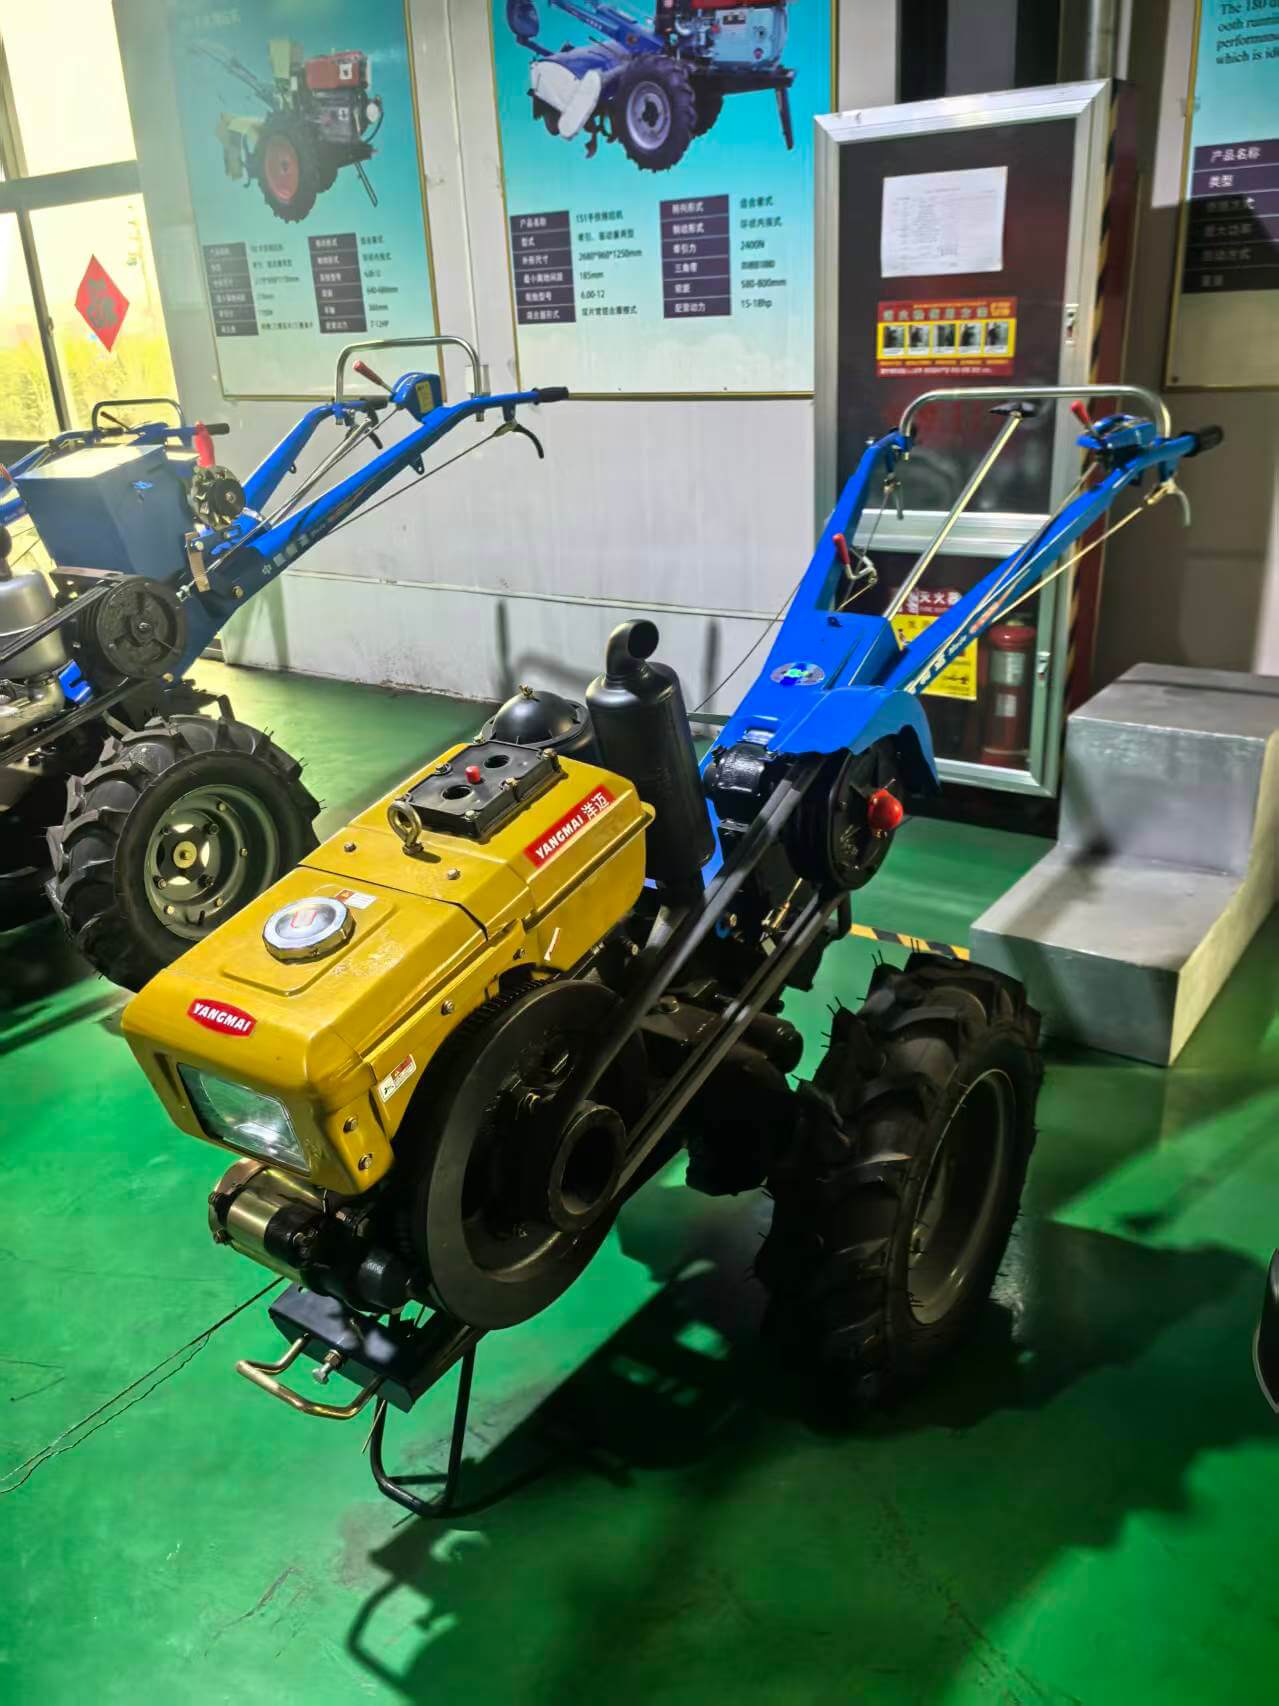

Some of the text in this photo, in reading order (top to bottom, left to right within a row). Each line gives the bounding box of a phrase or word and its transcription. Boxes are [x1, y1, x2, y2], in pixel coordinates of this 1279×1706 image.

[1221, 4, 1242, 15] The
[1247, 0, 1267, 11] 180
[1216, 50, 1249, 64] which
[1252, 48, 1262, 60] is
[1210, 147, 1261, 163] 产品名称
[1208, 175, 1233, 188] 类型
[520, 217, 547, 228] 产品名称
[673, 243, 697, 254] 牵引力
[522, 255, 549, 265] 外形尺寸
[581, 290, 605, 299] 6.00-12
[535, 791, 610, 859] YANGMAI 洋迈
[192, 1003, 252, 1032] YANGMAI
